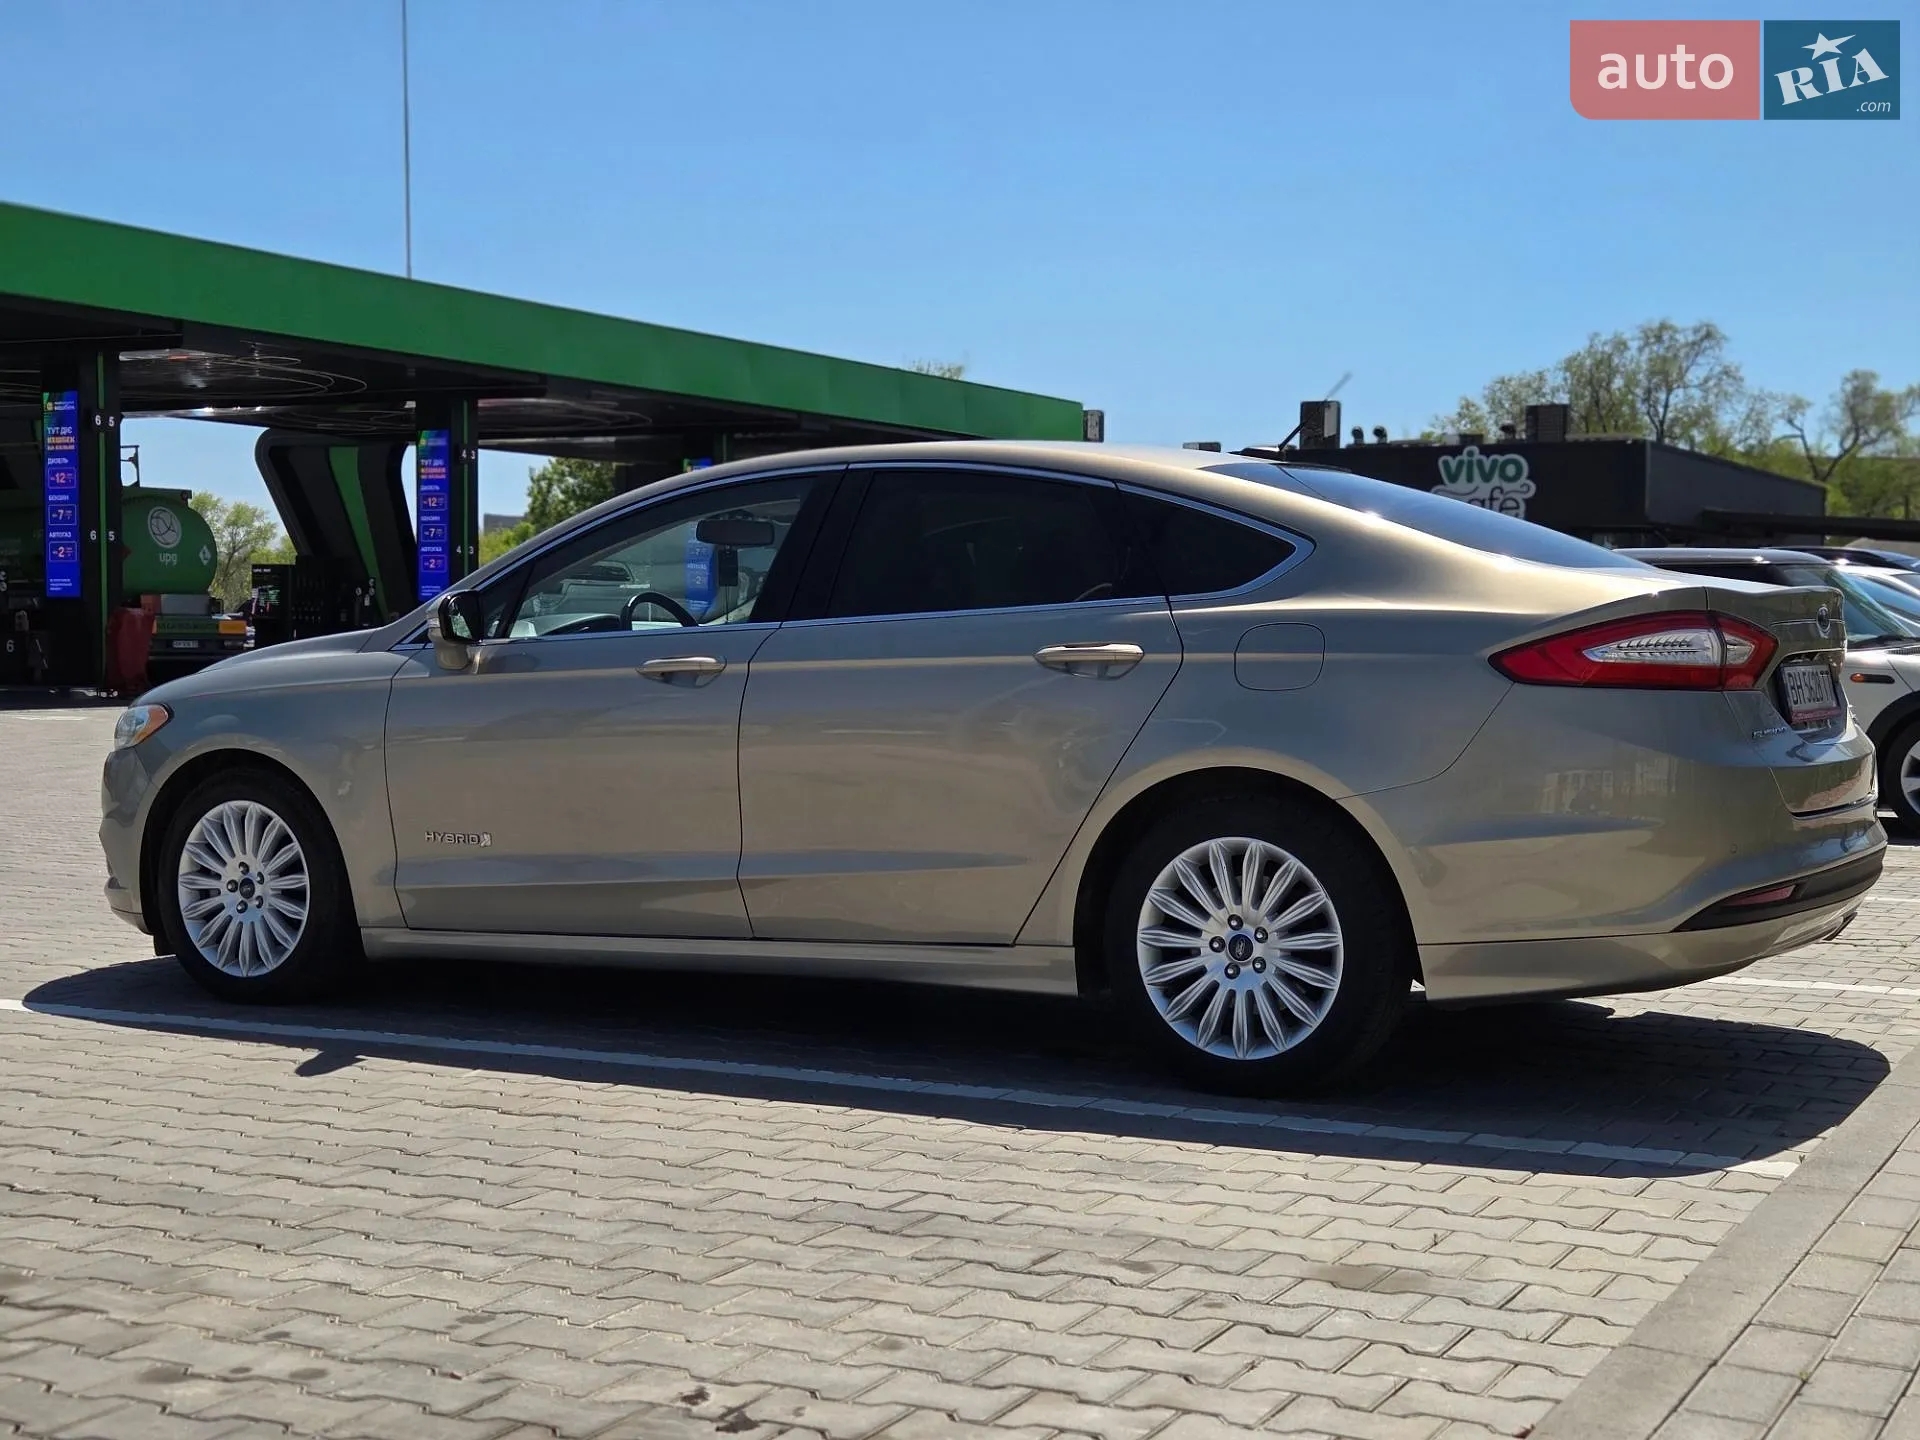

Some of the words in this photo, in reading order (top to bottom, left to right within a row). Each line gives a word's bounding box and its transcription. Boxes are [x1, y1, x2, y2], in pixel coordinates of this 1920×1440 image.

[95, 415, 101, 426] 6
[108, 416, 115, 427] 5
[1442, 449, 1524, 484] vivo
[89, 530, 97, 541] 6
[108, 531, 115, 541] 5
[159, 552, 178, 566] upg
[6, 639, 15, 653] 6
[1787, 671, 1806, 706] BH
[424, 831, 480, 845] HYBRID
